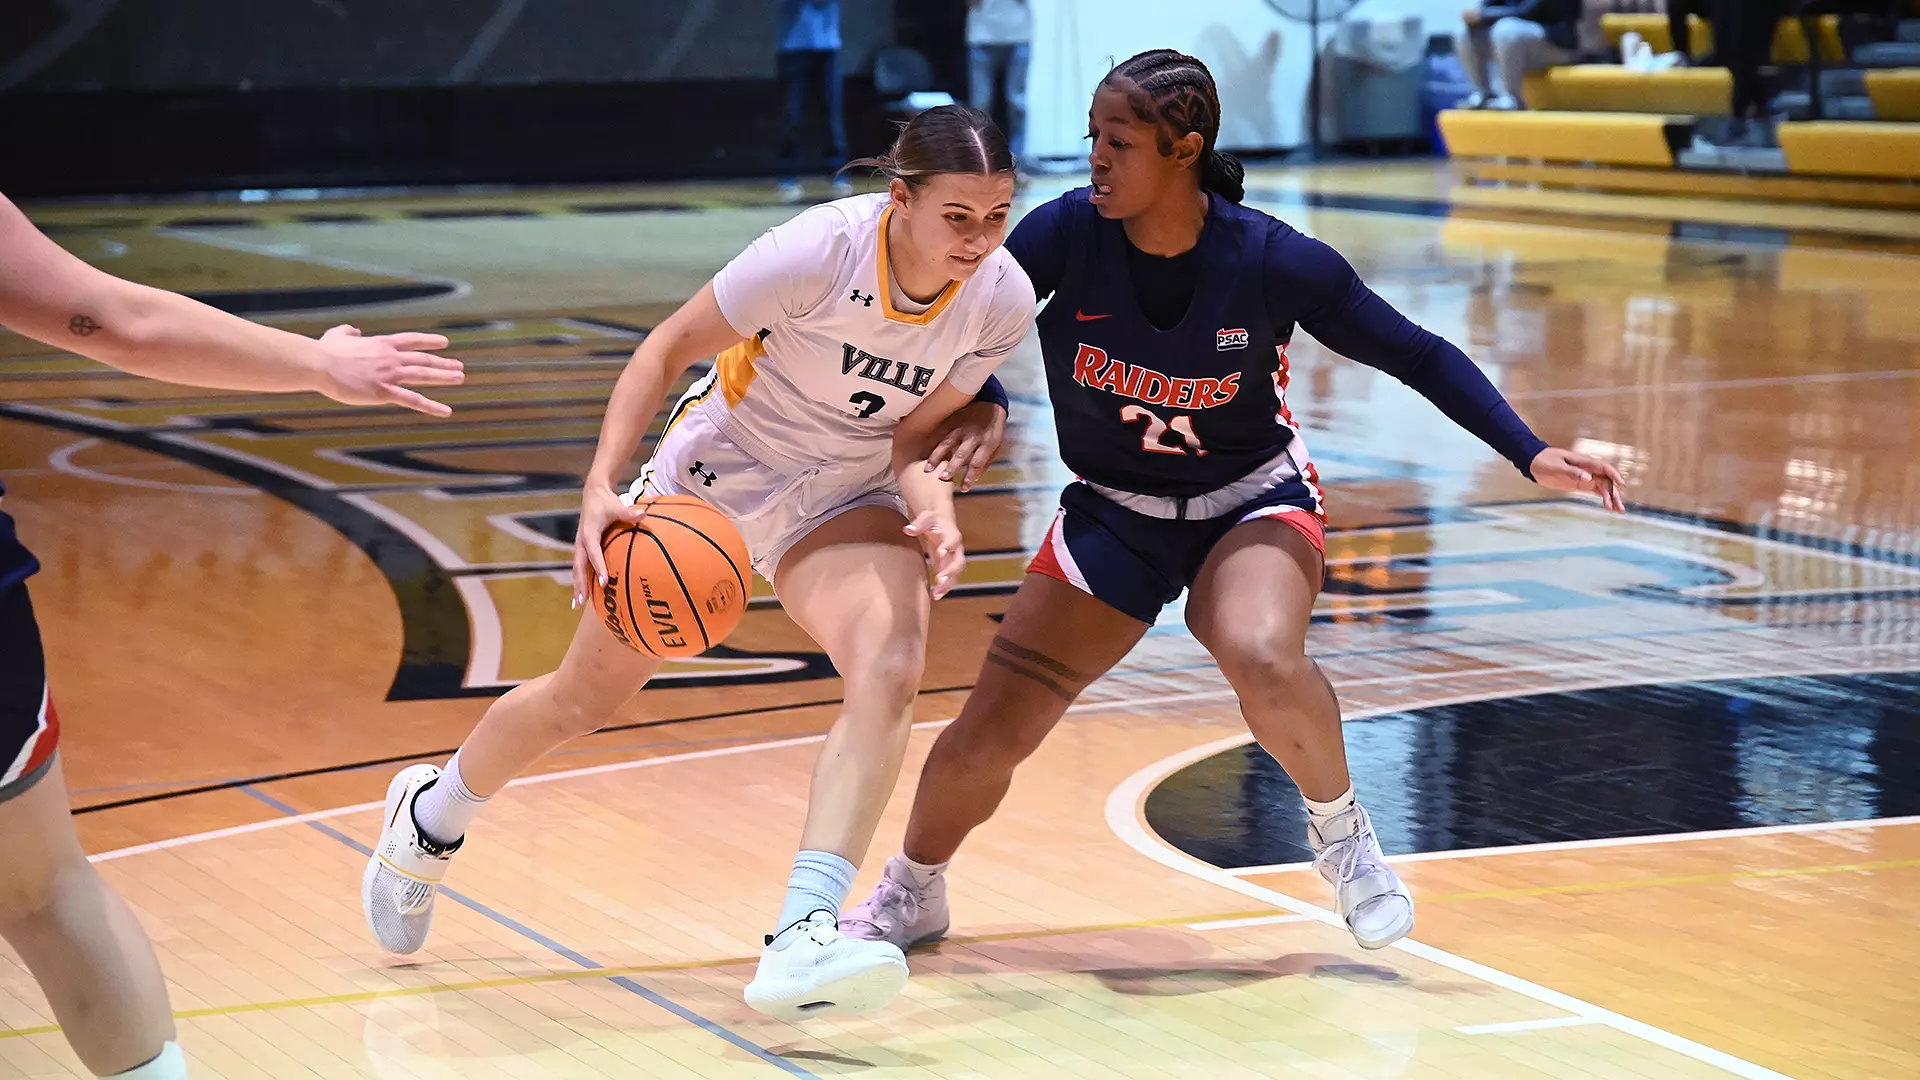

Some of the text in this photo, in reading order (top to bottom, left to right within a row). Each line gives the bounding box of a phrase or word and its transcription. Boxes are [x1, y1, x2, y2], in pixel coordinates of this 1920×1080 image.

[1217, 333, 1247, 345] PSAC
[841, 342, 936, 397] VILLE
[1072, 342, 1242, 410] RAIDERS
[1119, 404, 1209, 457] 21
